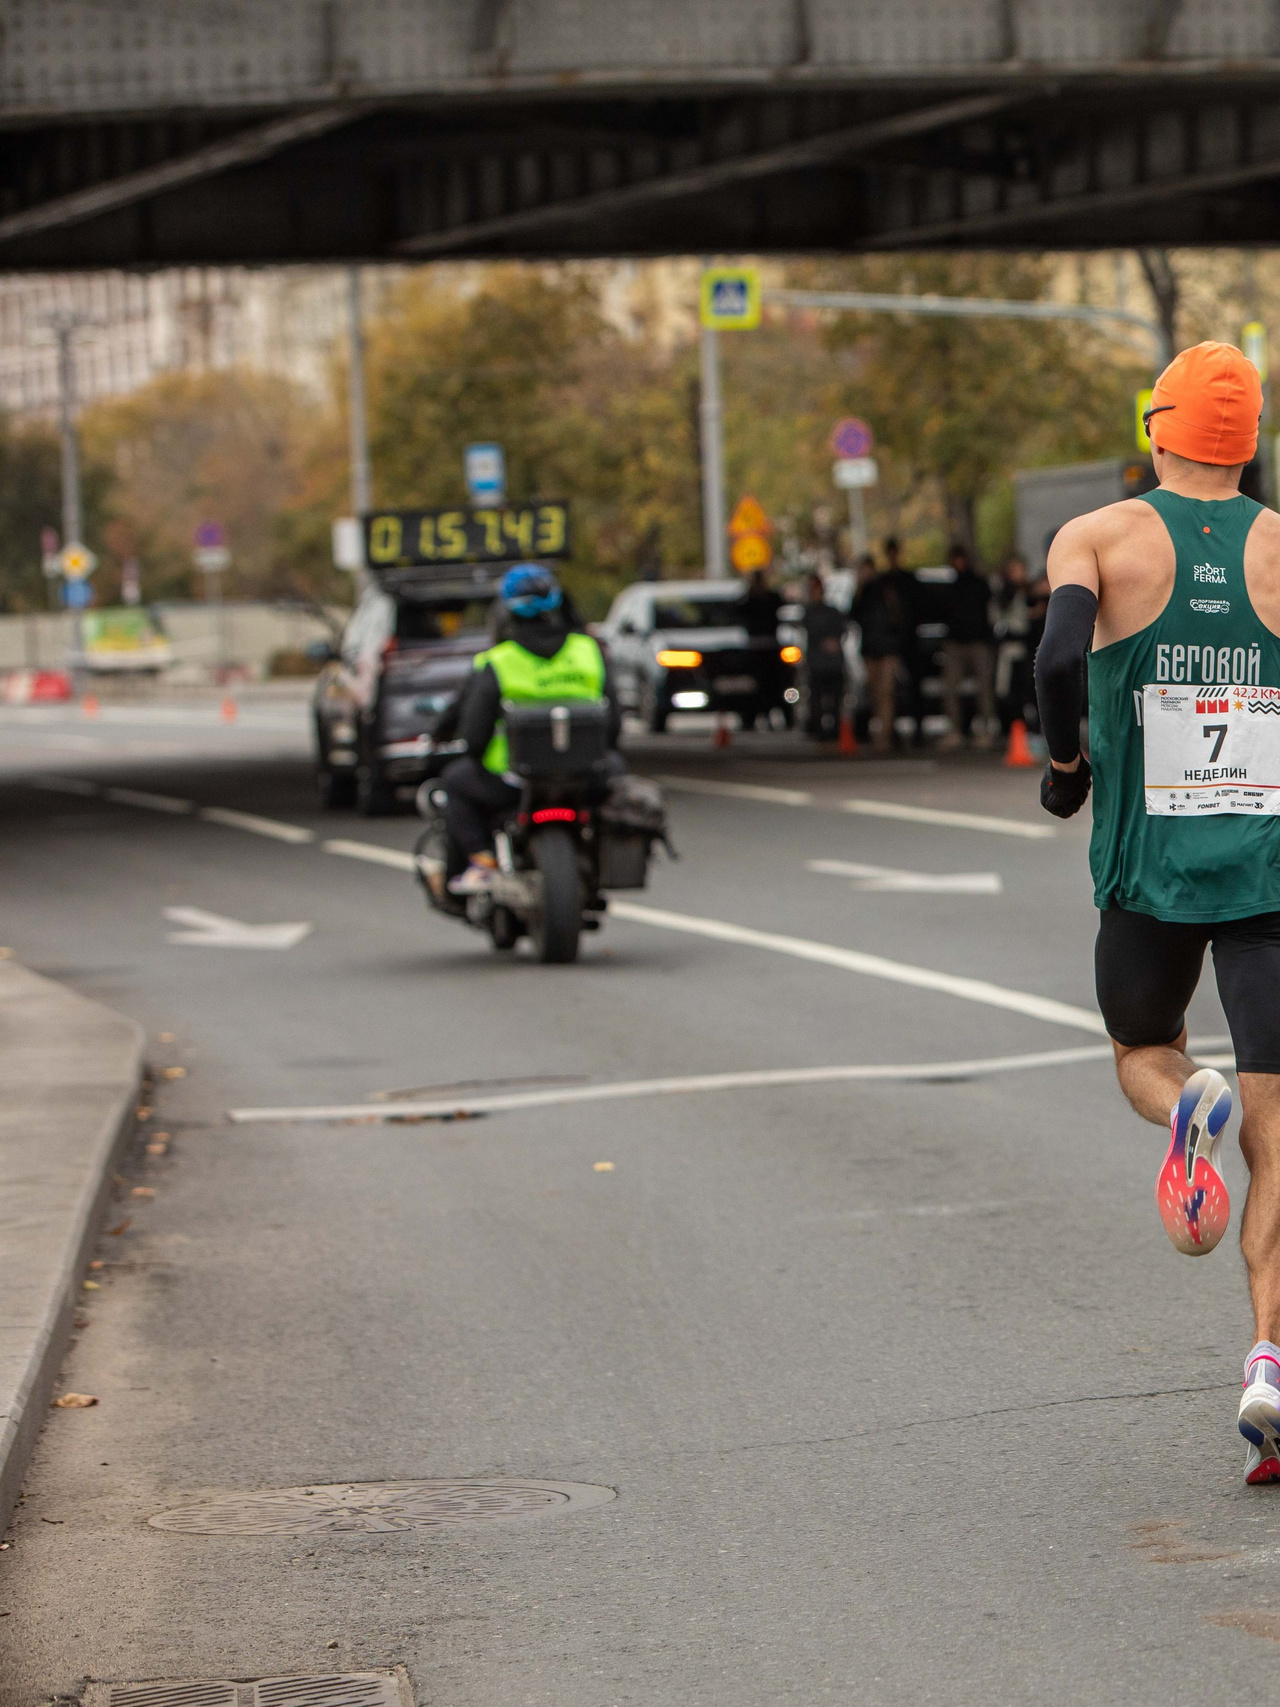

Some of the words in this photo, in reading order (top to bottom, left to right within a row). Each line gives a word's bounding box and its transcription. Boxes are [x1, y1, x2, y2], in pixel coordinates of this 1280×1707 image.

[1193, 563, 1227, 576] SPORT
[1193, 573, 1228, 585] FERMA
[1232, 687, 1258, 699] 42,2
[1202, 724, 1228, 763] 7
[1184, 768, 1247, 782] НЕДЕЛИН
[1197, 802, 1220, 810] FONBET
